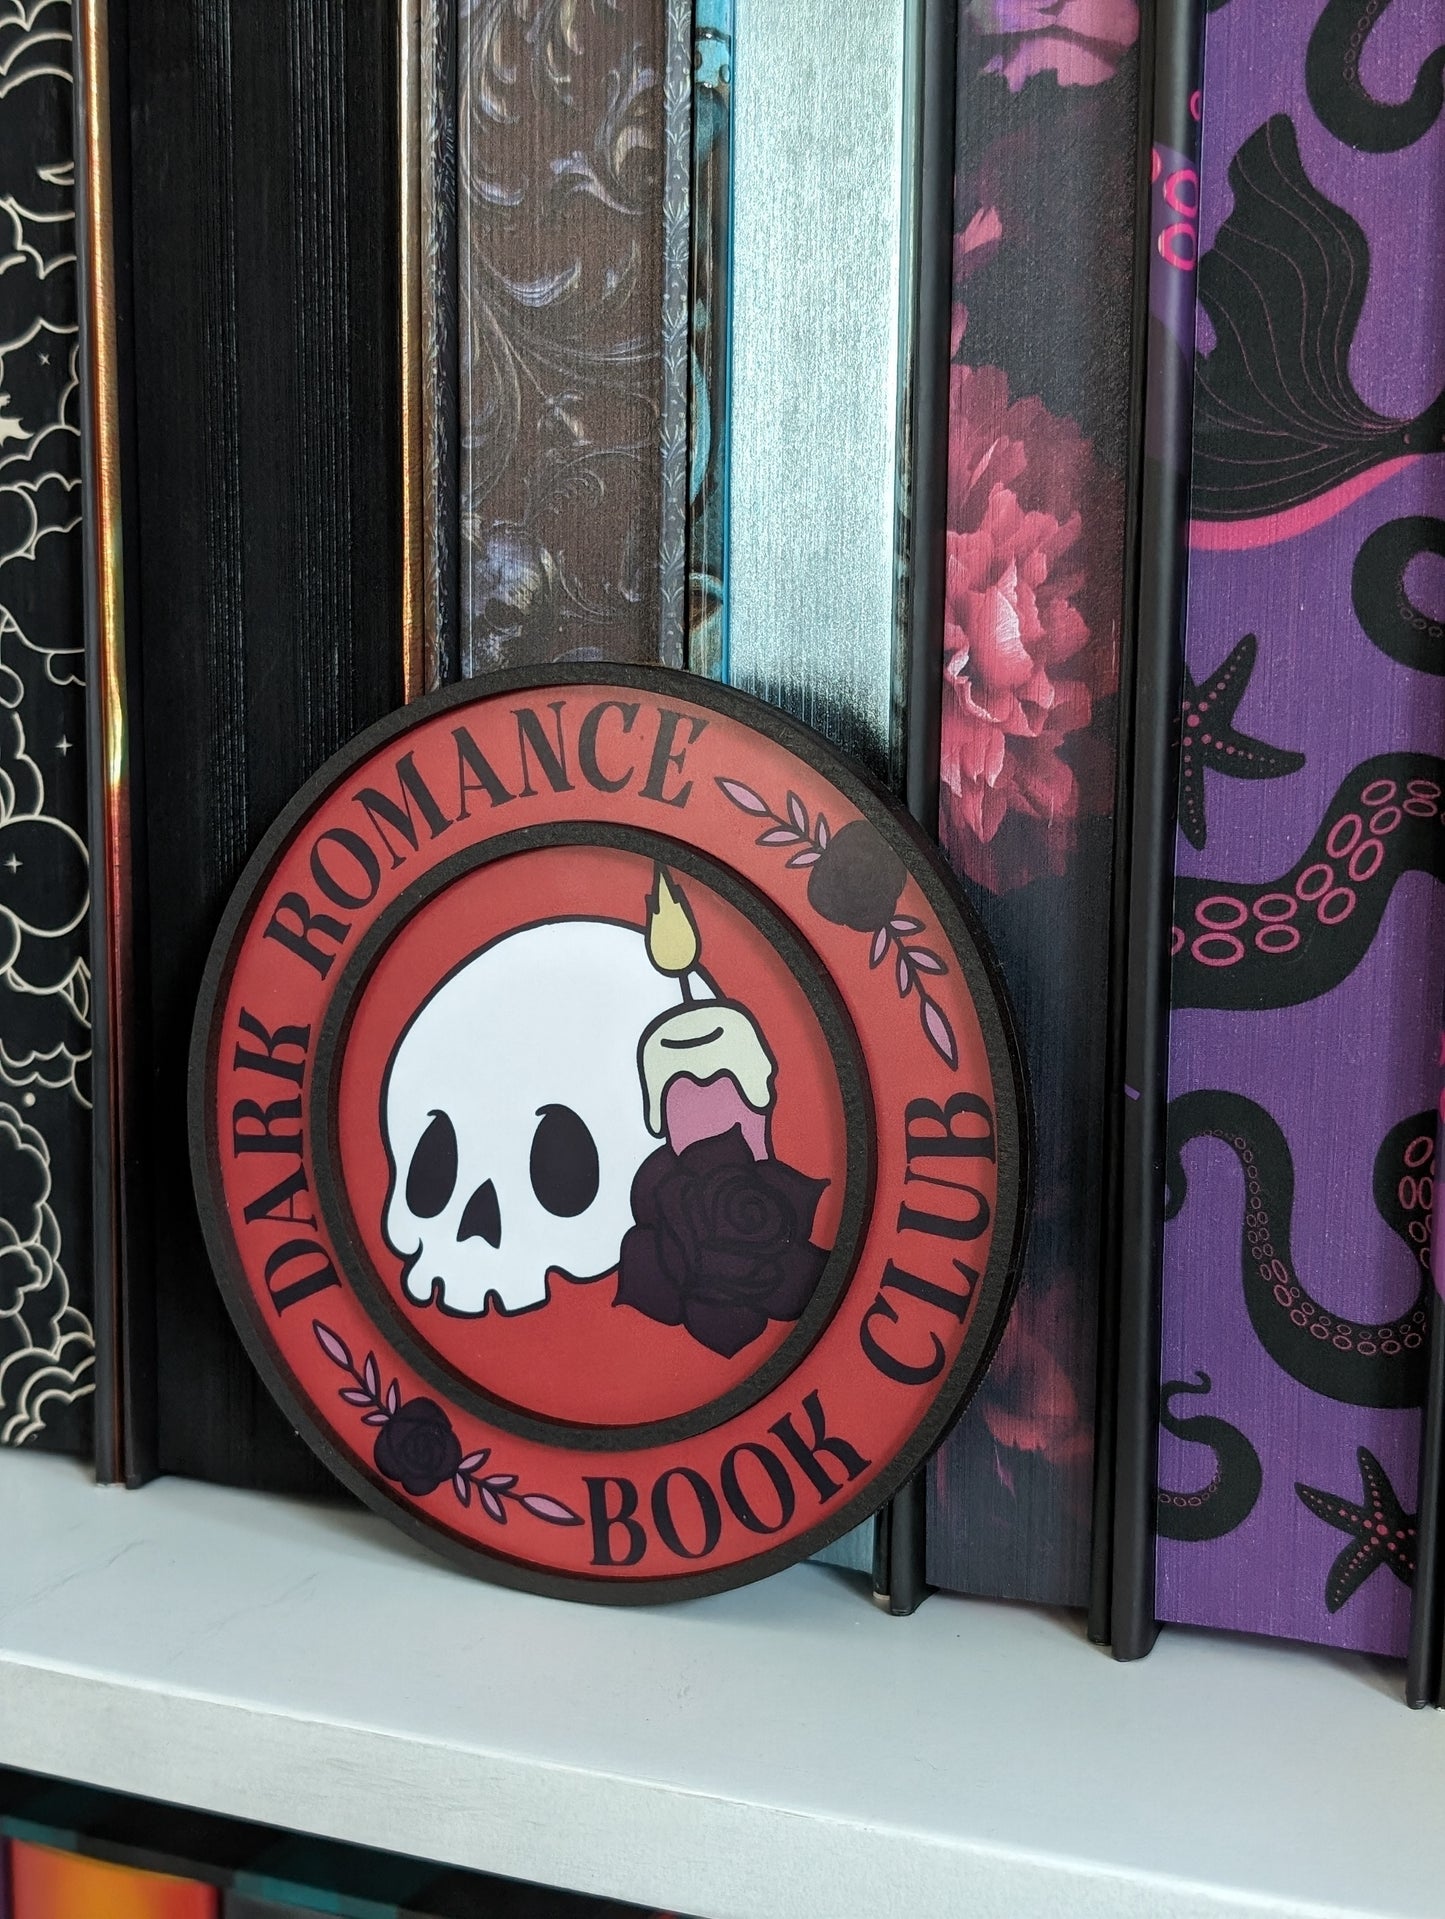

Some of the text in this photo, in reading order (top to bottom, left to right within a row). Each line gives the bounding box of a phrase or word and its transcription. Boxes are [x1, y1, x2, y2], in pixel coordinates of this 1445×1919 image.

[232, 701, 711, 1318] DARK ROMANCE
[581, 1091, 997, 1567] BOOK CLUB
